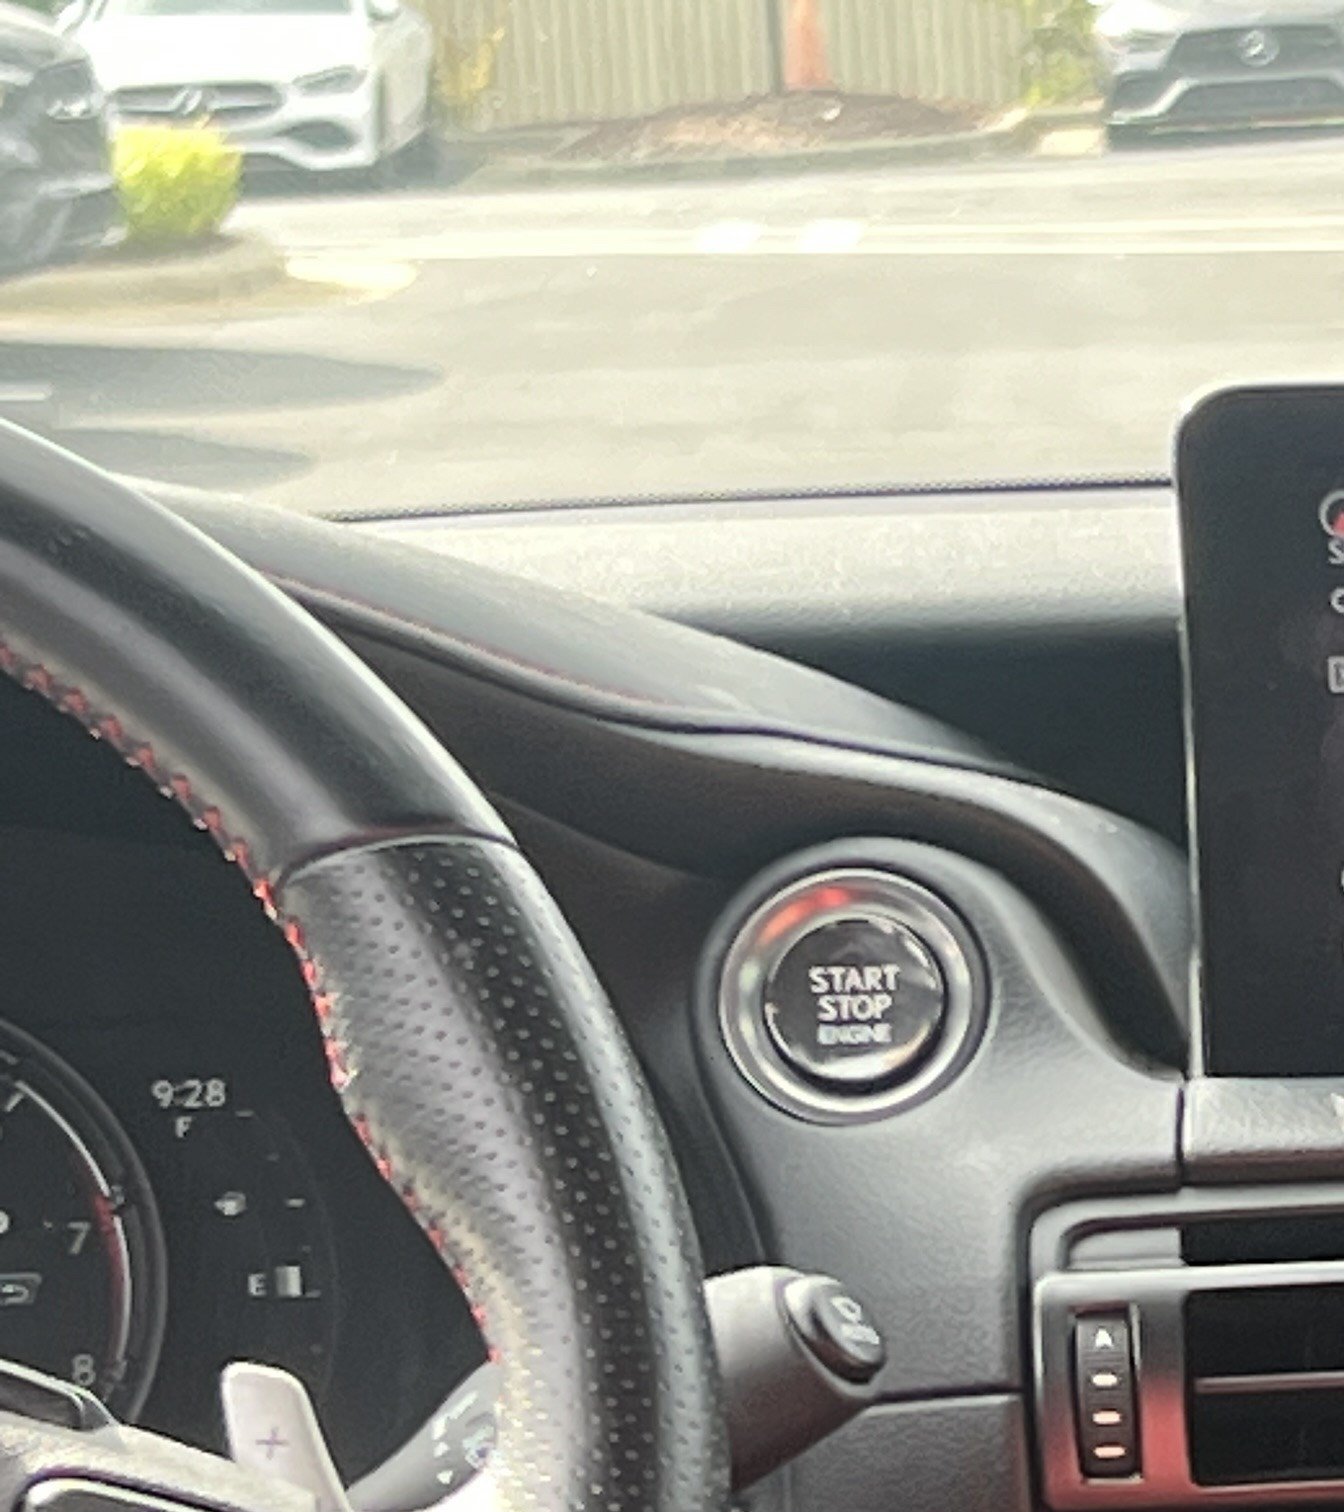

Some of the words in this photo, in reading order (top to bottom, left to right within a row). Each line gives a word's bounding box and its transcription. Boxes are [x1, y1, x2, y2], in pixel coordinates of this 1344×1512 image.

[808, 964, 900, 993] START
[817, 993, 893, 1021] STOP
[817, 1023, 893, 1045] ENGINE
[151, 1078, 226, 1108] 9:28
[174, 1115, 193, 1138] F
[68, 1222, 91, 1254] 7
[248, 1273, 267, 1297] E
[72, 1353, 95, 1387] 8
